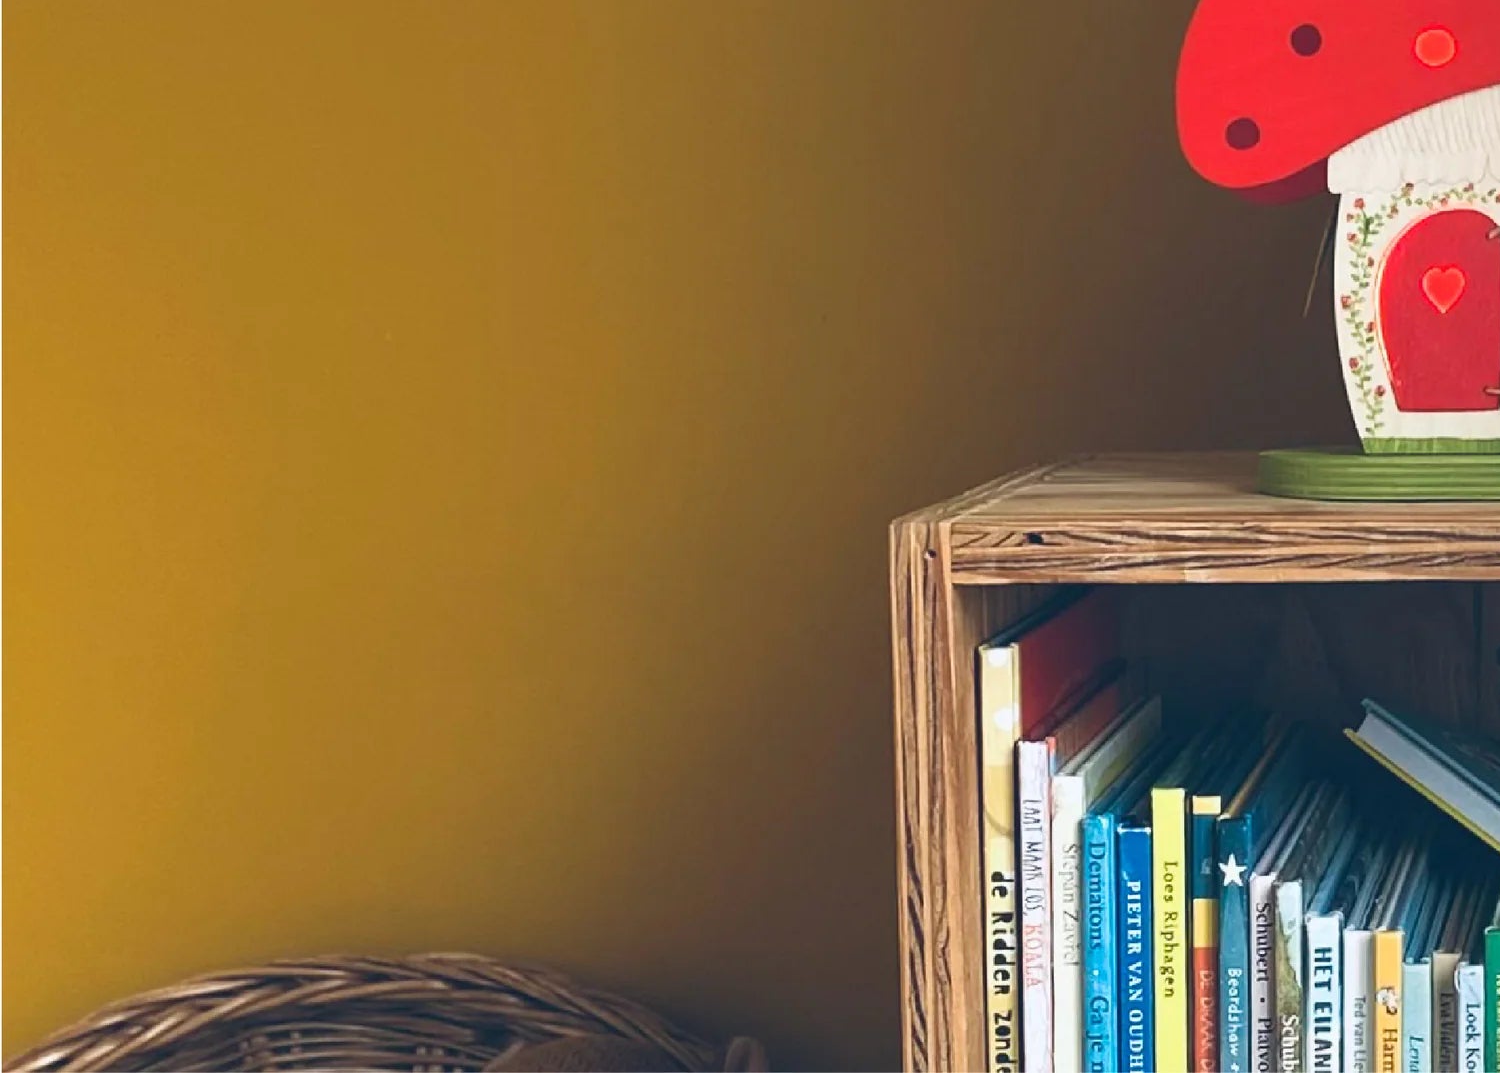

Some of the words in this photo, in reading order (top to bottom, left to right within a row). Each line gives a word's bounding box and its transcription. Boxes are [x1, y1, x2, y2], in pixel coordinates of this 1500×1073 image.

[1022, 800, 1044, 832] LAAT
[1022, 841, 1044, 880] MAAR
[991, 871, 1014, 899] de
[1088, 842, 1107, 950] Dematons
[1163, 861, 1179, 903] Loes
[1126, 880, 1142, 955] PIETER
[1025, 923, 1043, 990] KOALA
[1160, 911, 1179, 998] Riphagen
[1256, 902, 1274, 982] Schubert
[1128, 962, 1142, 1002] VAN
[1199, 970, 1215, 993] DE
[1313, 947, 1333, 992] HET
[1090, 995, 1109, 1025] Ga
[1226, 967, 1243, 1056] Beardshaw
[1354, 996, 1366, 1018] Ted
[1465, 1003, 1482, 1043] Loek
[1086, 1033, 1109, 1053] je
[1128, 1009, 1144, 1073] OUDH
[1313, 1001, 1333, 1073] EILAN
[1354, 1022, 1366, 1046] van
[1354, 1049, 1367, 1073] Lie
[1466, 1047, 1481, 1073] Ko
